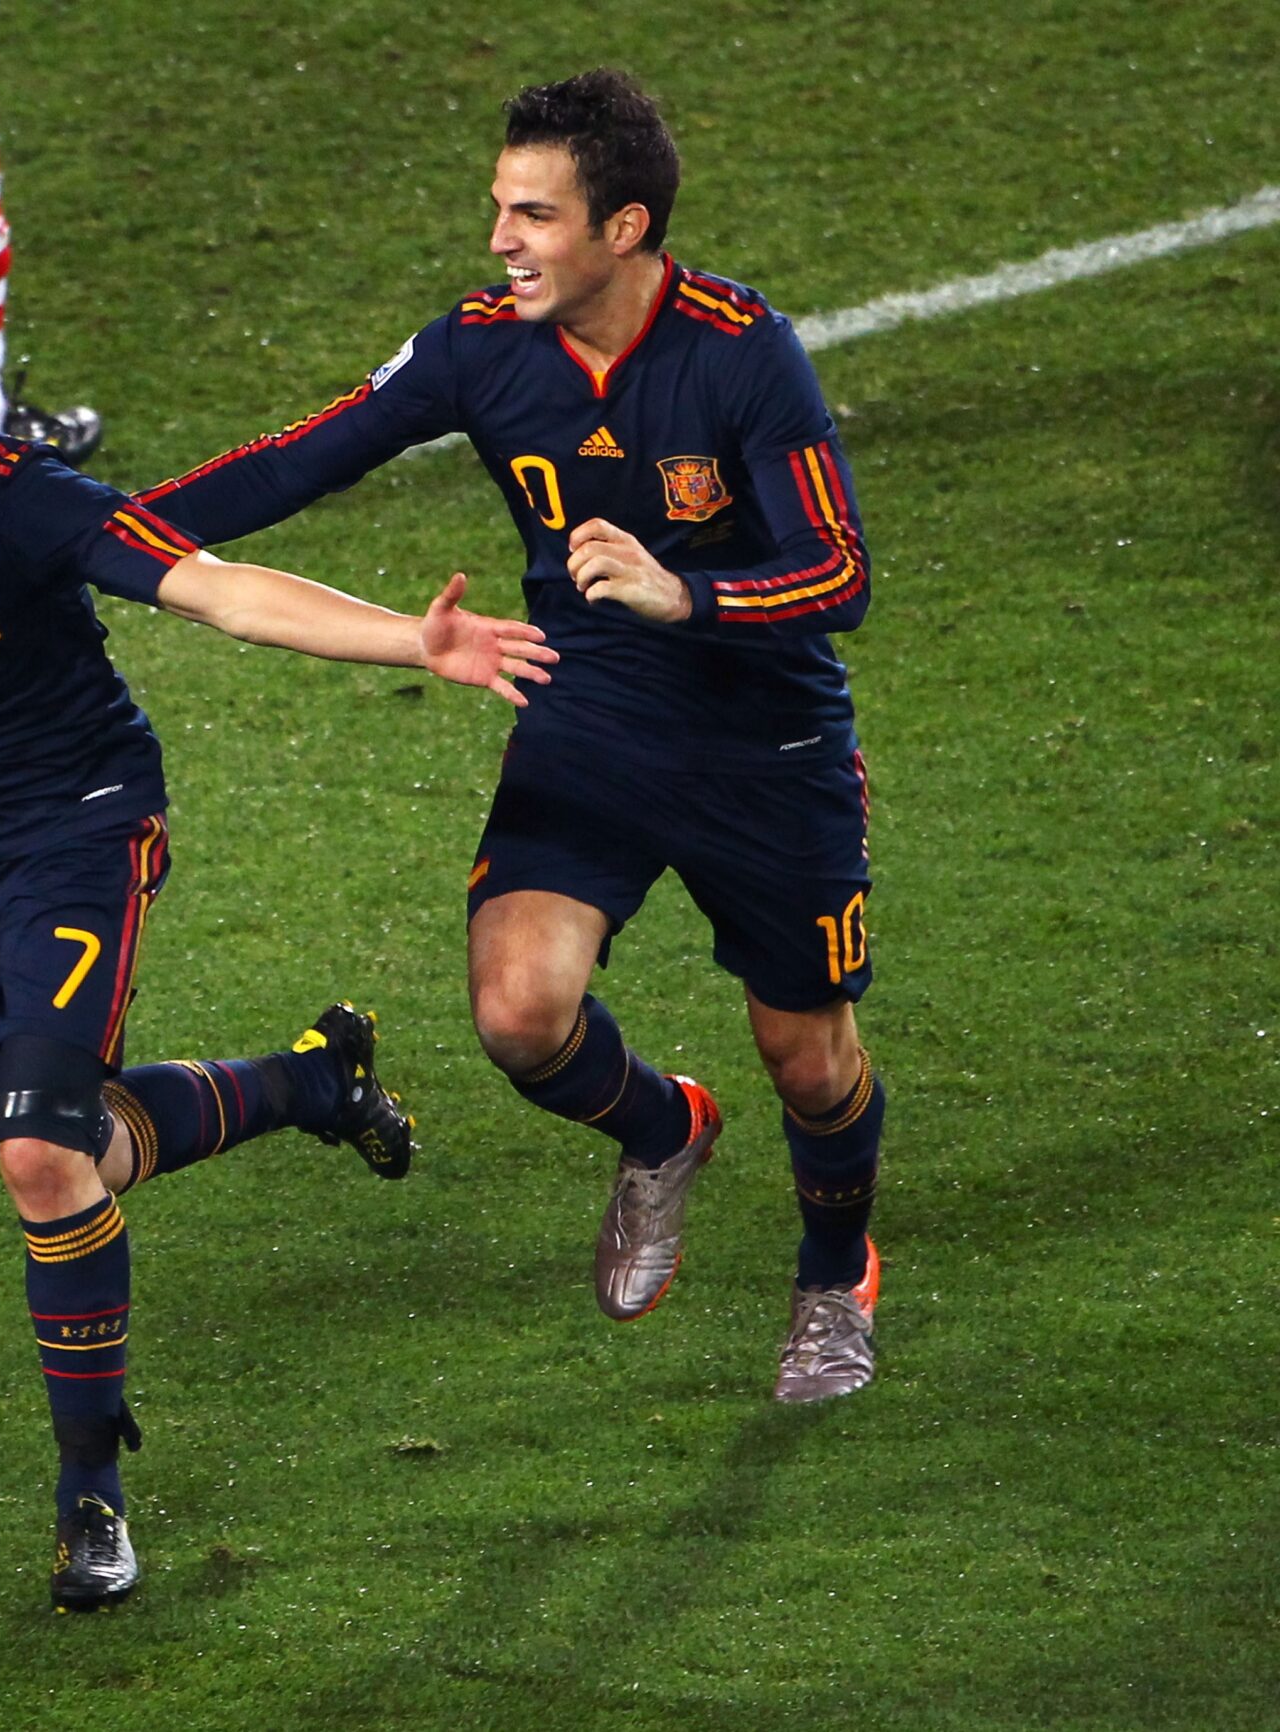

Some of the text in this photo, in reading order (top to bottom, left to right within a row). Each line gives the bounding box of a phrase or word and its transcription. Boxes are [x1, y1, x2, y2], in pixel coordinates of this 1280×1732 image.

[578, 446, 625, 458] adidas
[52, 926, 101, 1010] 7
[816, 890, 866, 985] 10
